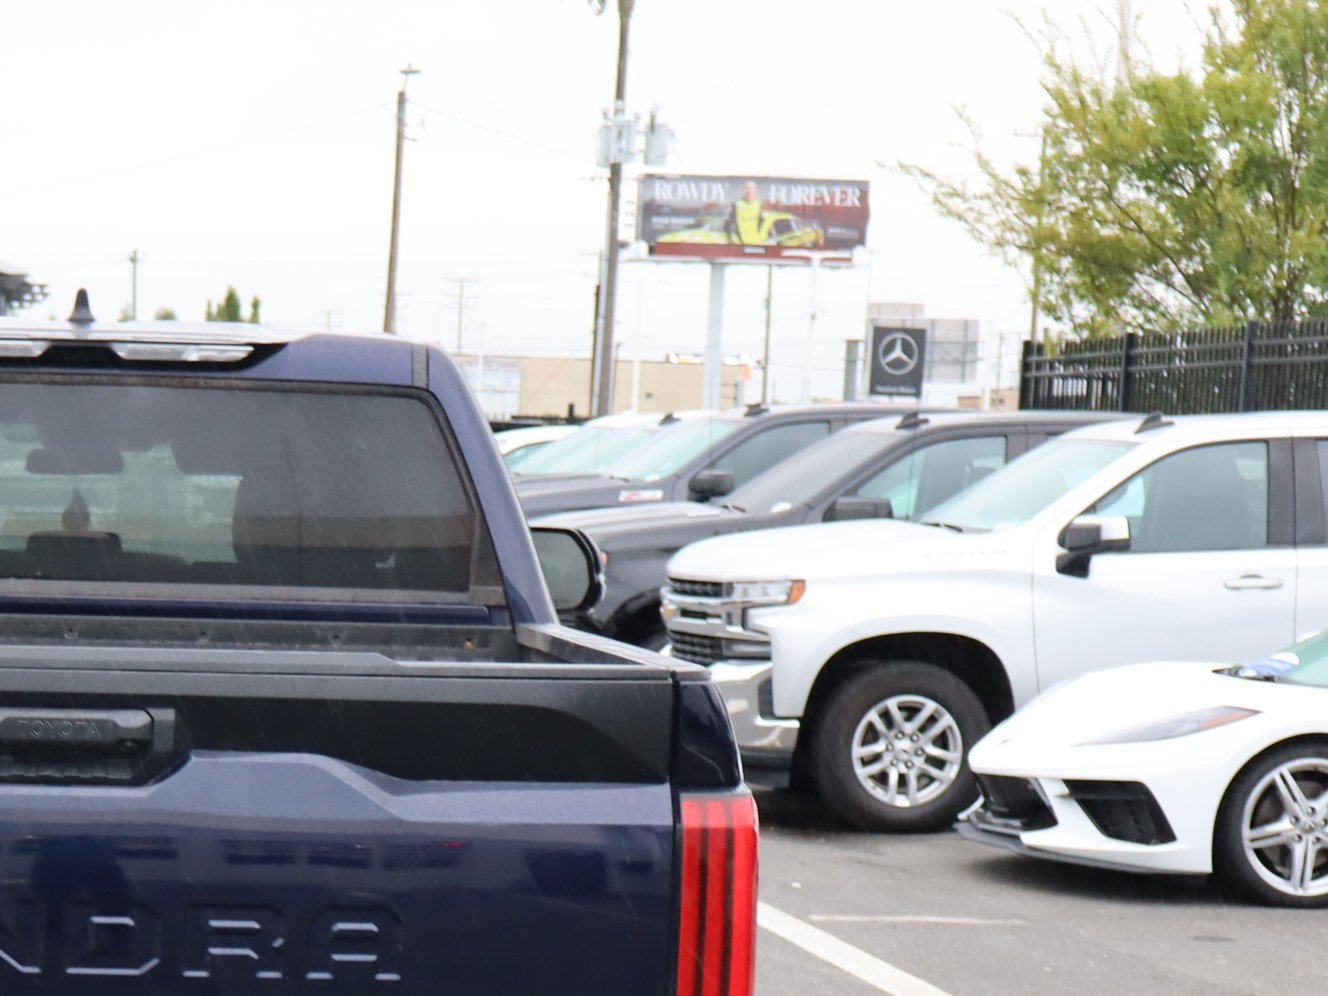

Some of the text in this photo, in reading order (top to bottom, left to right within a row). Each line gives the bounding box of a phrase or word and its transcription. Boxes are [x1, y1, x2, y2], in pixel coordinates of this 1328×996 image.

[655, 181, 861, 207] ROWDY FOREVER
[15, 720, 103, 738] TOYOTA
